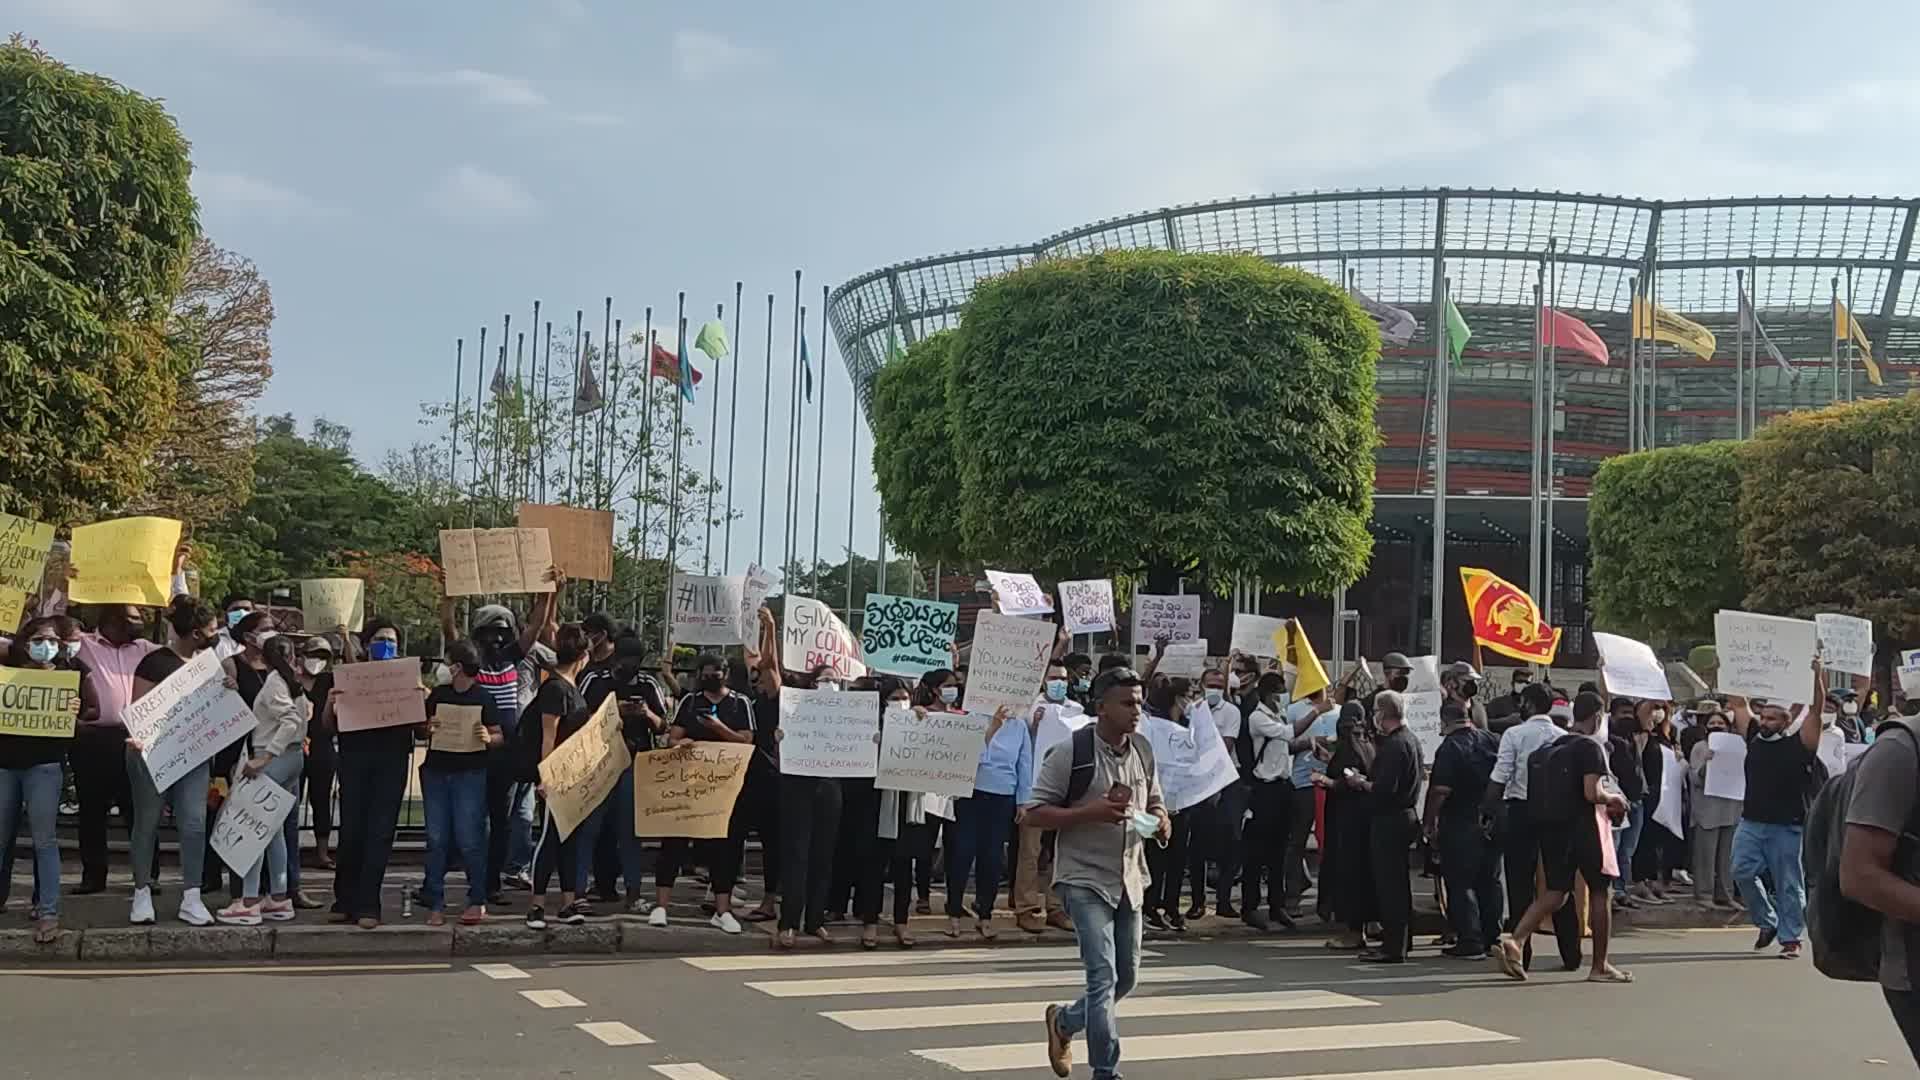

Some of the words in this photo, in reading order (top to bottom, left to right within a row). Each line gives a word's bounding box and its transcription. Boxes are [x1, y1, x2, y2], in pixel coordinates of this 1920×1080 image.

[794, 605, 838, 632] GIVE
[786, 625, 809, 646] MY
[130, 686, 168, 728] ARREST
[187, 662, 208, 679] THE
[901, 730, 918, 743] TO
[889, 746, 921, 760] NOT
[253, 784, 281, 813] US
